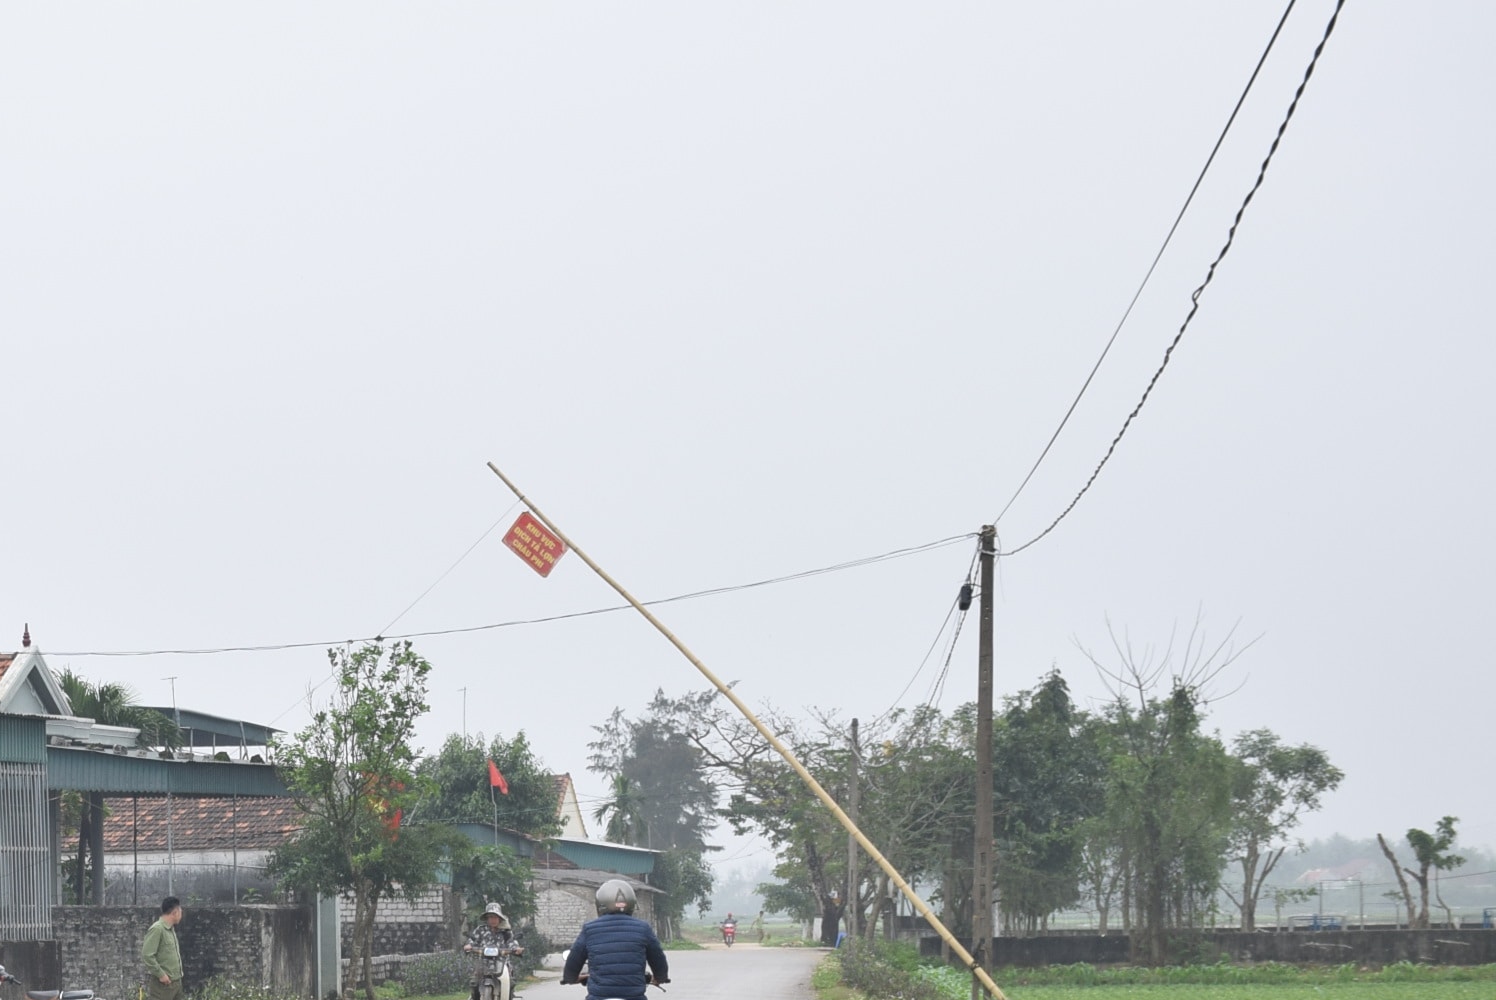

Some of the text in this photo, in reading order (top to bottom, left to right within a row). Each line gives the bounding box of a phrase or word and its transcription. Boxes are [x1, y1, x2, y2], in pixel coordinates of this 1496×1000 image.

[514, 527, 532, 543] DỊCH
[540, 548, 555, 564] LỢN
[527, 523, 556, 550] KHU VỰC
[513, 539, 544, 568] CHÂU PHI
